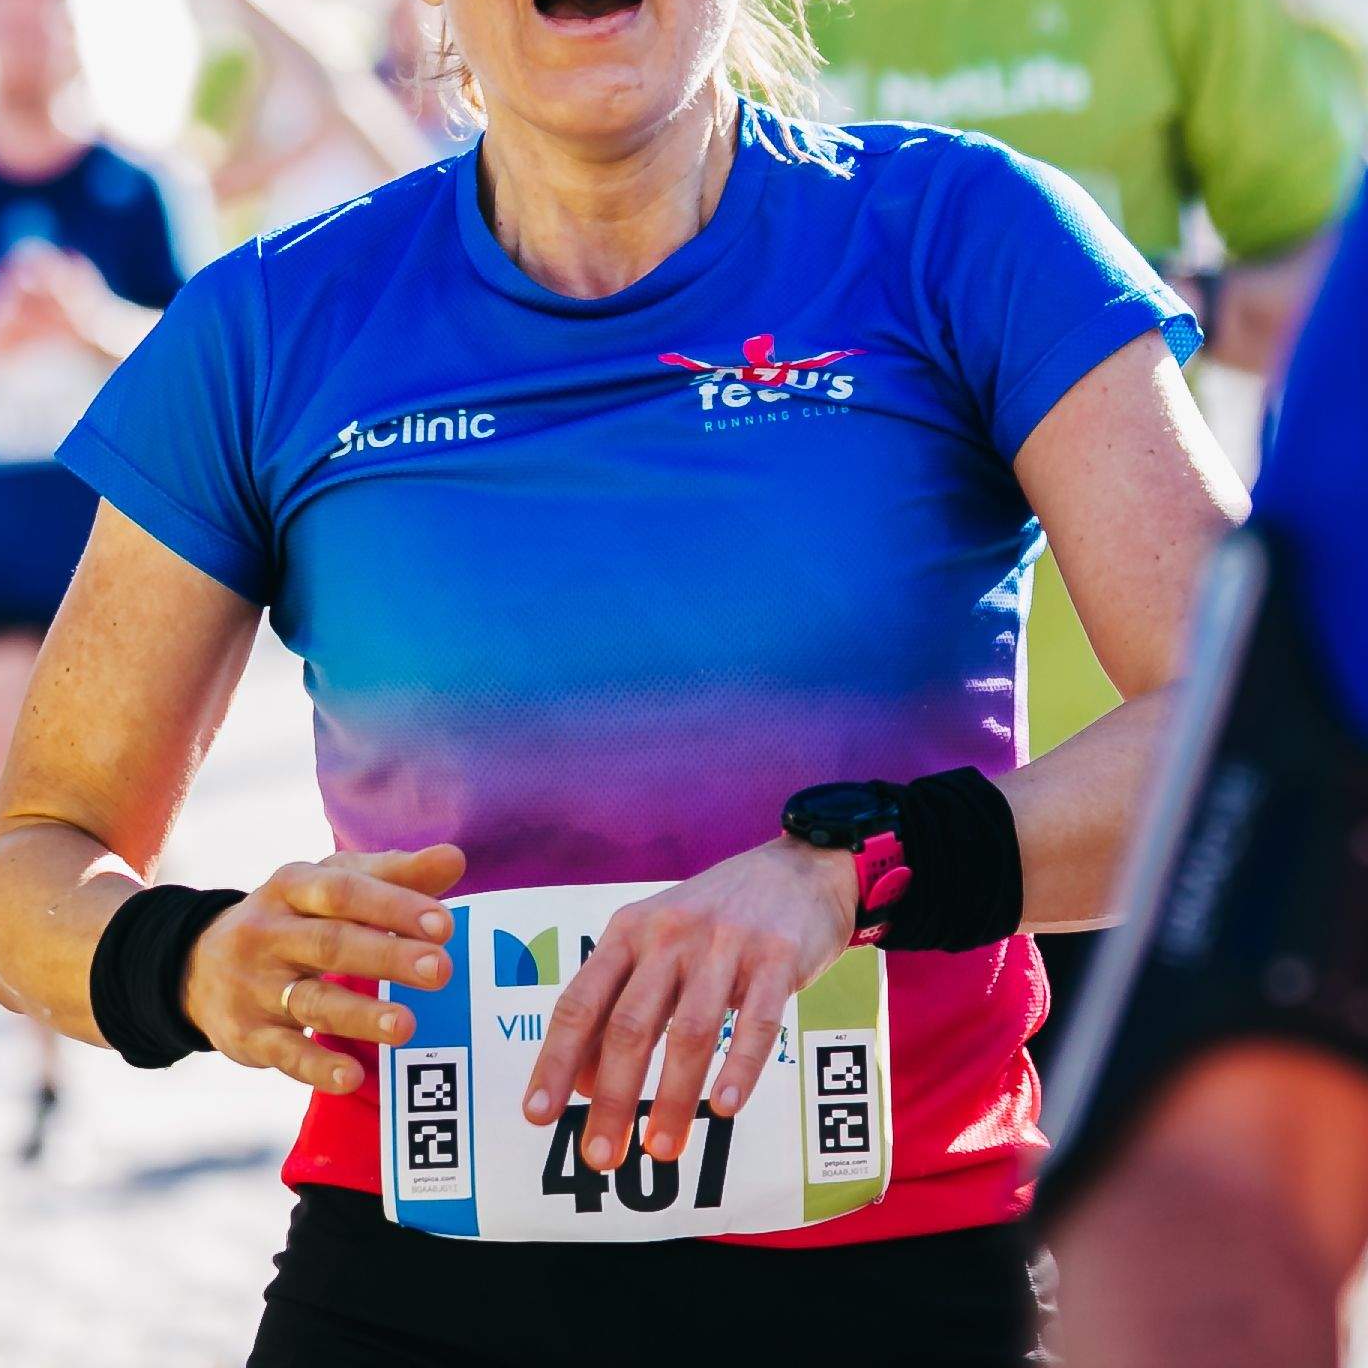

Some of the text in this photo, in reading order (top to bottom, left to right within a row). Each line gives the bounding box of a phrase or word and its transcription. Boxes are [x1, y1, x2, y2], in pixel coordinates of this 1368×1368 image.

[704, 410, 790, 432] RUNNING
[497, 1013, 542, 1041] VIII
[542, 1098, 734, 1213] 467
